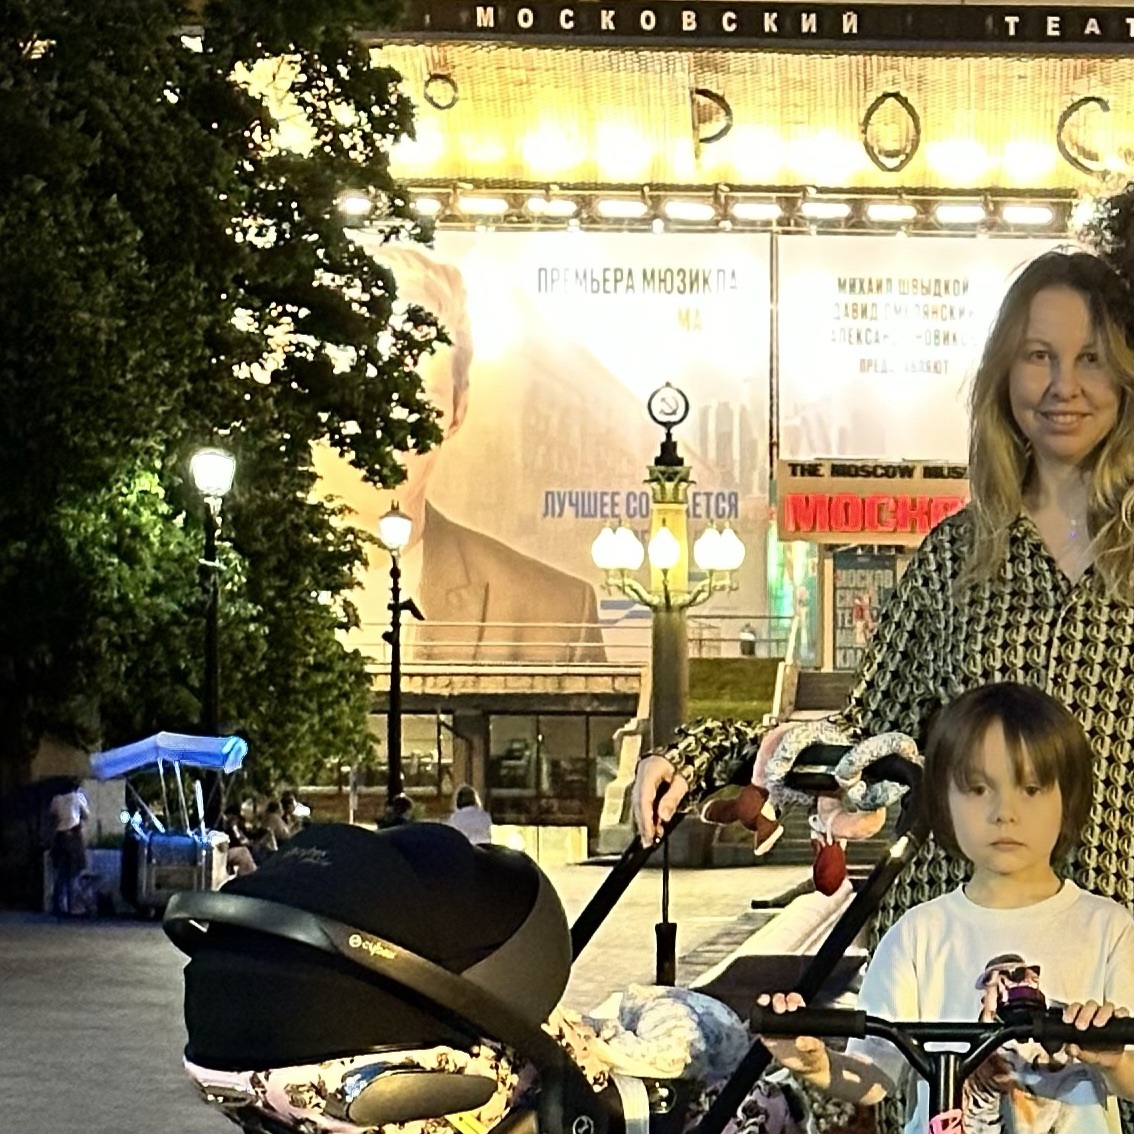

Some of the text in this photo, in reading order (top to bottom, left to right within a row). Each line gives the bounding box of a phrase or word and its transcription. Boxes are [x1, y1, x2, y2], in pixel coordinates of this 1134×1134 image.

[475, 6, 859, 34] МОСКОВСКИЙ
[538, 267, 738, 295] ПРЕМЬЕРА МЮЗИКЛА
[837, 277, 893, 295] МИХАИЛ
[788, 463, 969, 479] THE MOSCOW MUS
[543, 491, 620, 519] ЛУЧШЕЕ
